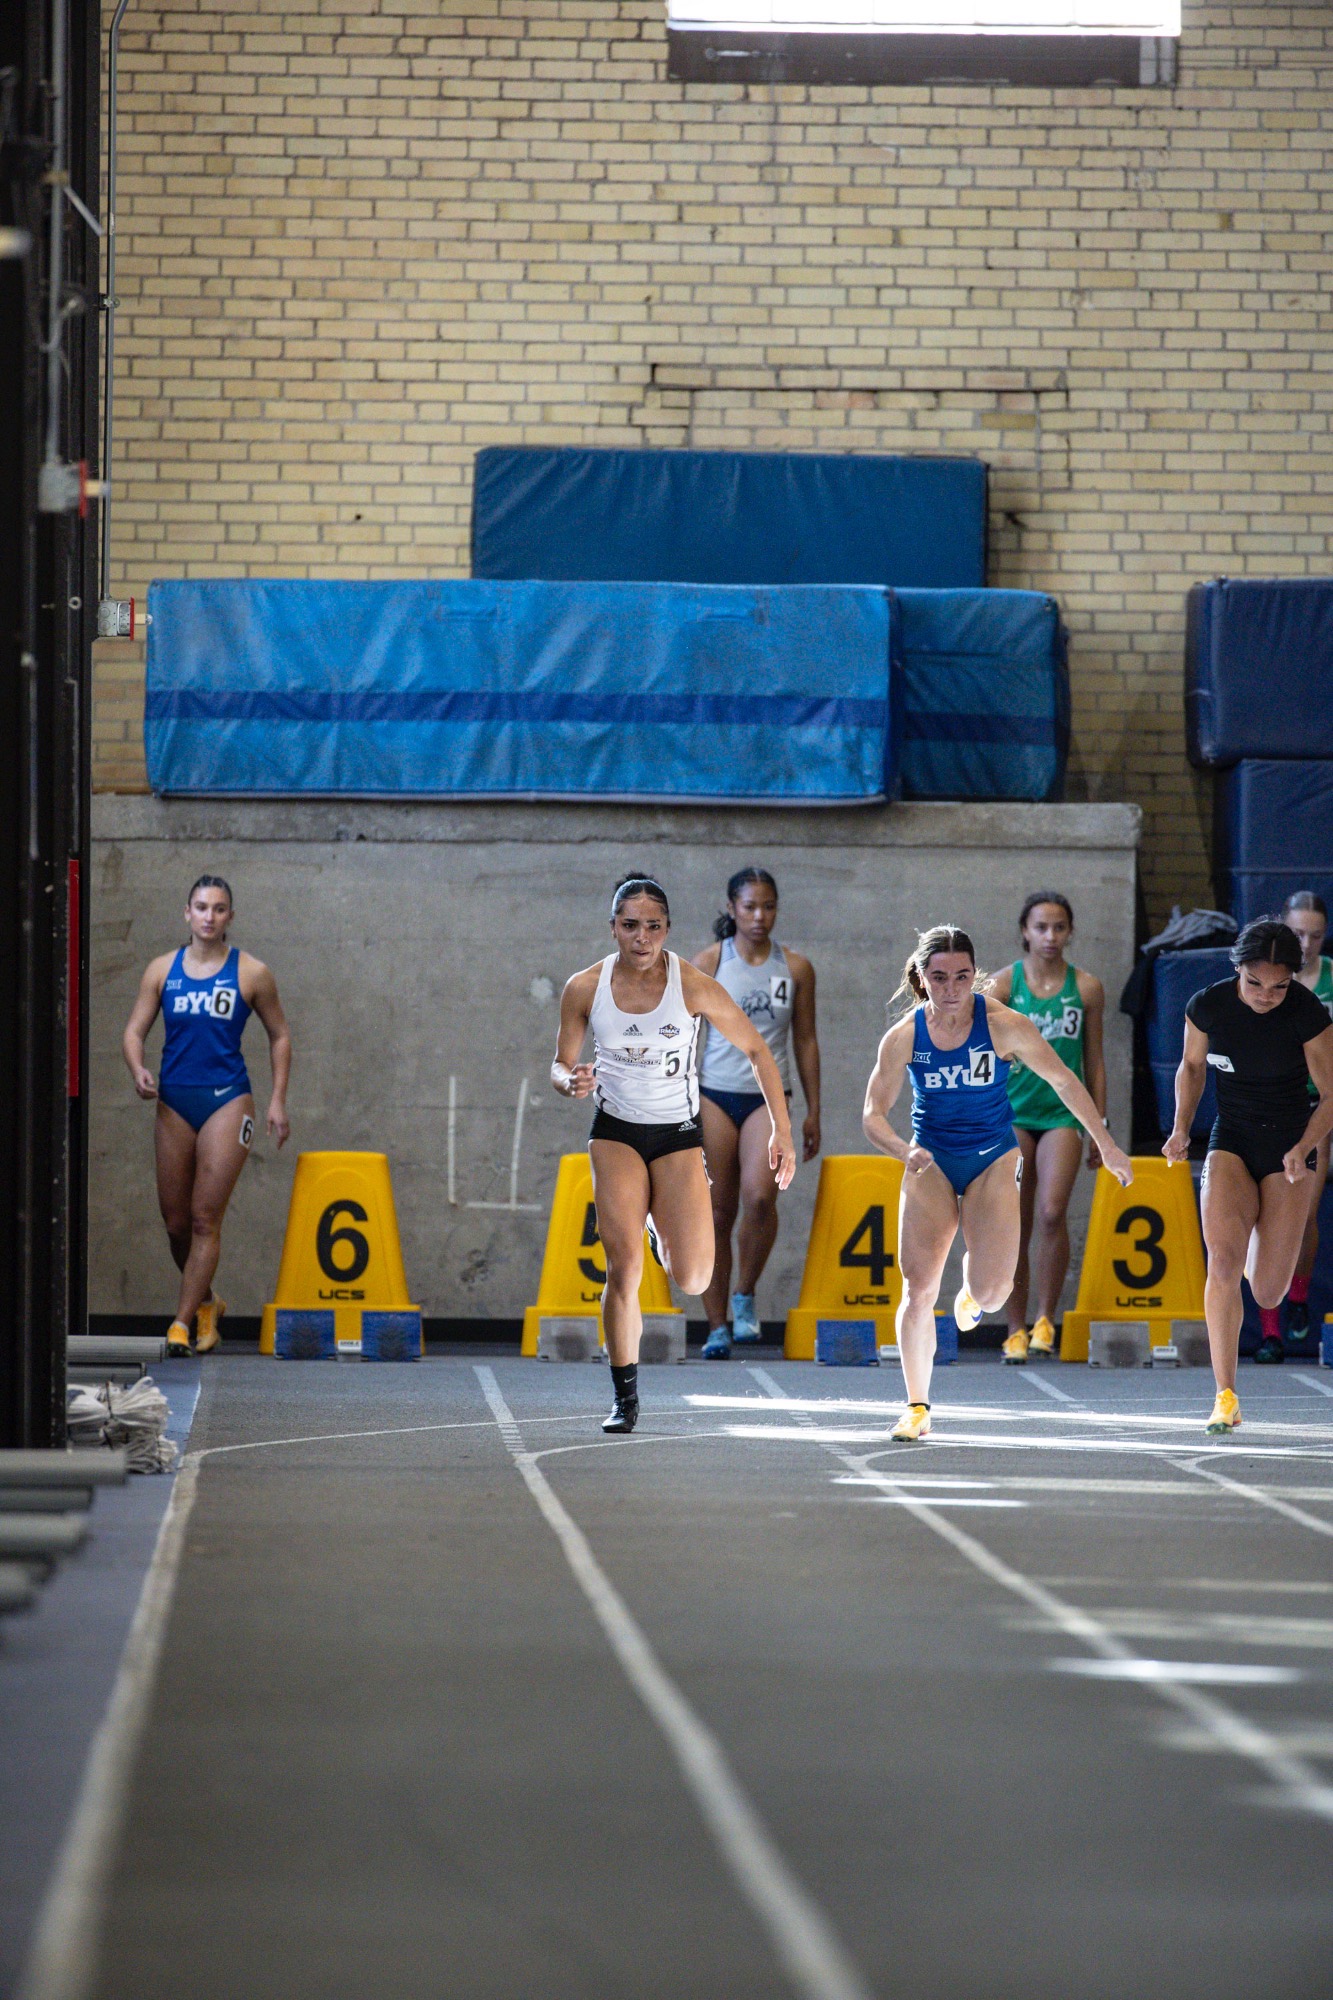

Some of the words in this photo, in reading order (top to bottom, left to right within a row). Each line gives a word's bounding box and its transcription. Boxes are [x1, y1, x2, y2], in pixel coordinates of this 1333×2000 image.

[215, 990, 231, 1015] 6
[775, 980, 787, 1004] 4
[1065, 1010, 1078, 1035] 3
[665, 1050, 680, 1077] 5
[974, 1053, 991, 1083] 4
[242, 1119, 253, 1144] 6
[316, 1199, 369, 1282] 6
[839, 1205, 894, 1286] 4
[1112, 1205, 1167, 1289] 3
[318, 1289, 365, 1300] UCS
[843, 1294, 891, 1305] UCS
[1115, 1296, 1163, 1307] UCS
